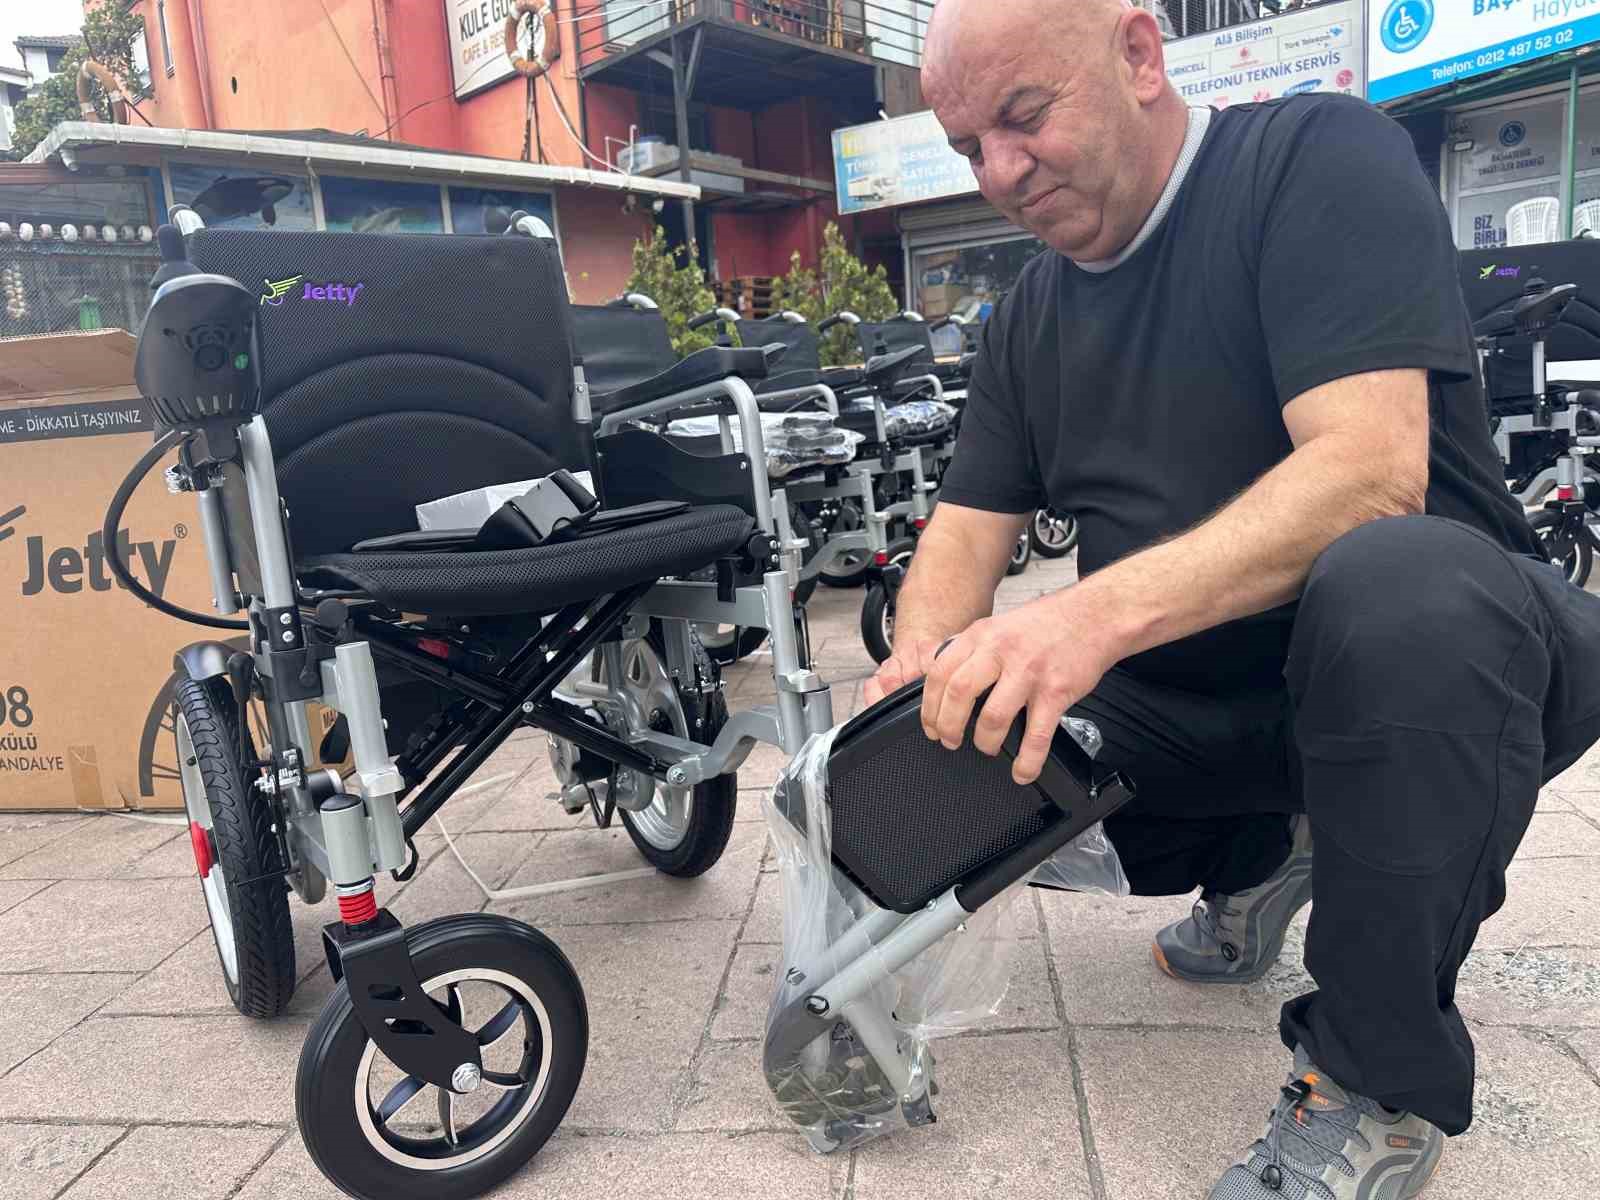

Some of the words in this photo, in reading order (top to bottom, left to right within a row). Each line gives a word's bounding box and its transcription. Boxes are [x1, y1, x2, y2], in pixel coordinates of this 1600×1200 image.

[459, 2, 489, 41] KULE
[1431, 60, 1475, 80] Telefon:
[1477, 50, 1505, 66] 0212
[1507, 41, 1531, 56] 487
[1535, 34, 1552, 50] 52
[1555, 28, 1574, 44] 02
[1181, 73, 1243, 97] TELEFONU
[1247, 62, 1292, 83] TEKNİK
[1295, 51, 1340, 73] SERVİS
[302, 282, 363, 306] Jetty
[26, 411, 79, 432] DİKKATLİ
[81, 409, 142, 429] TAŞIYINIZ
